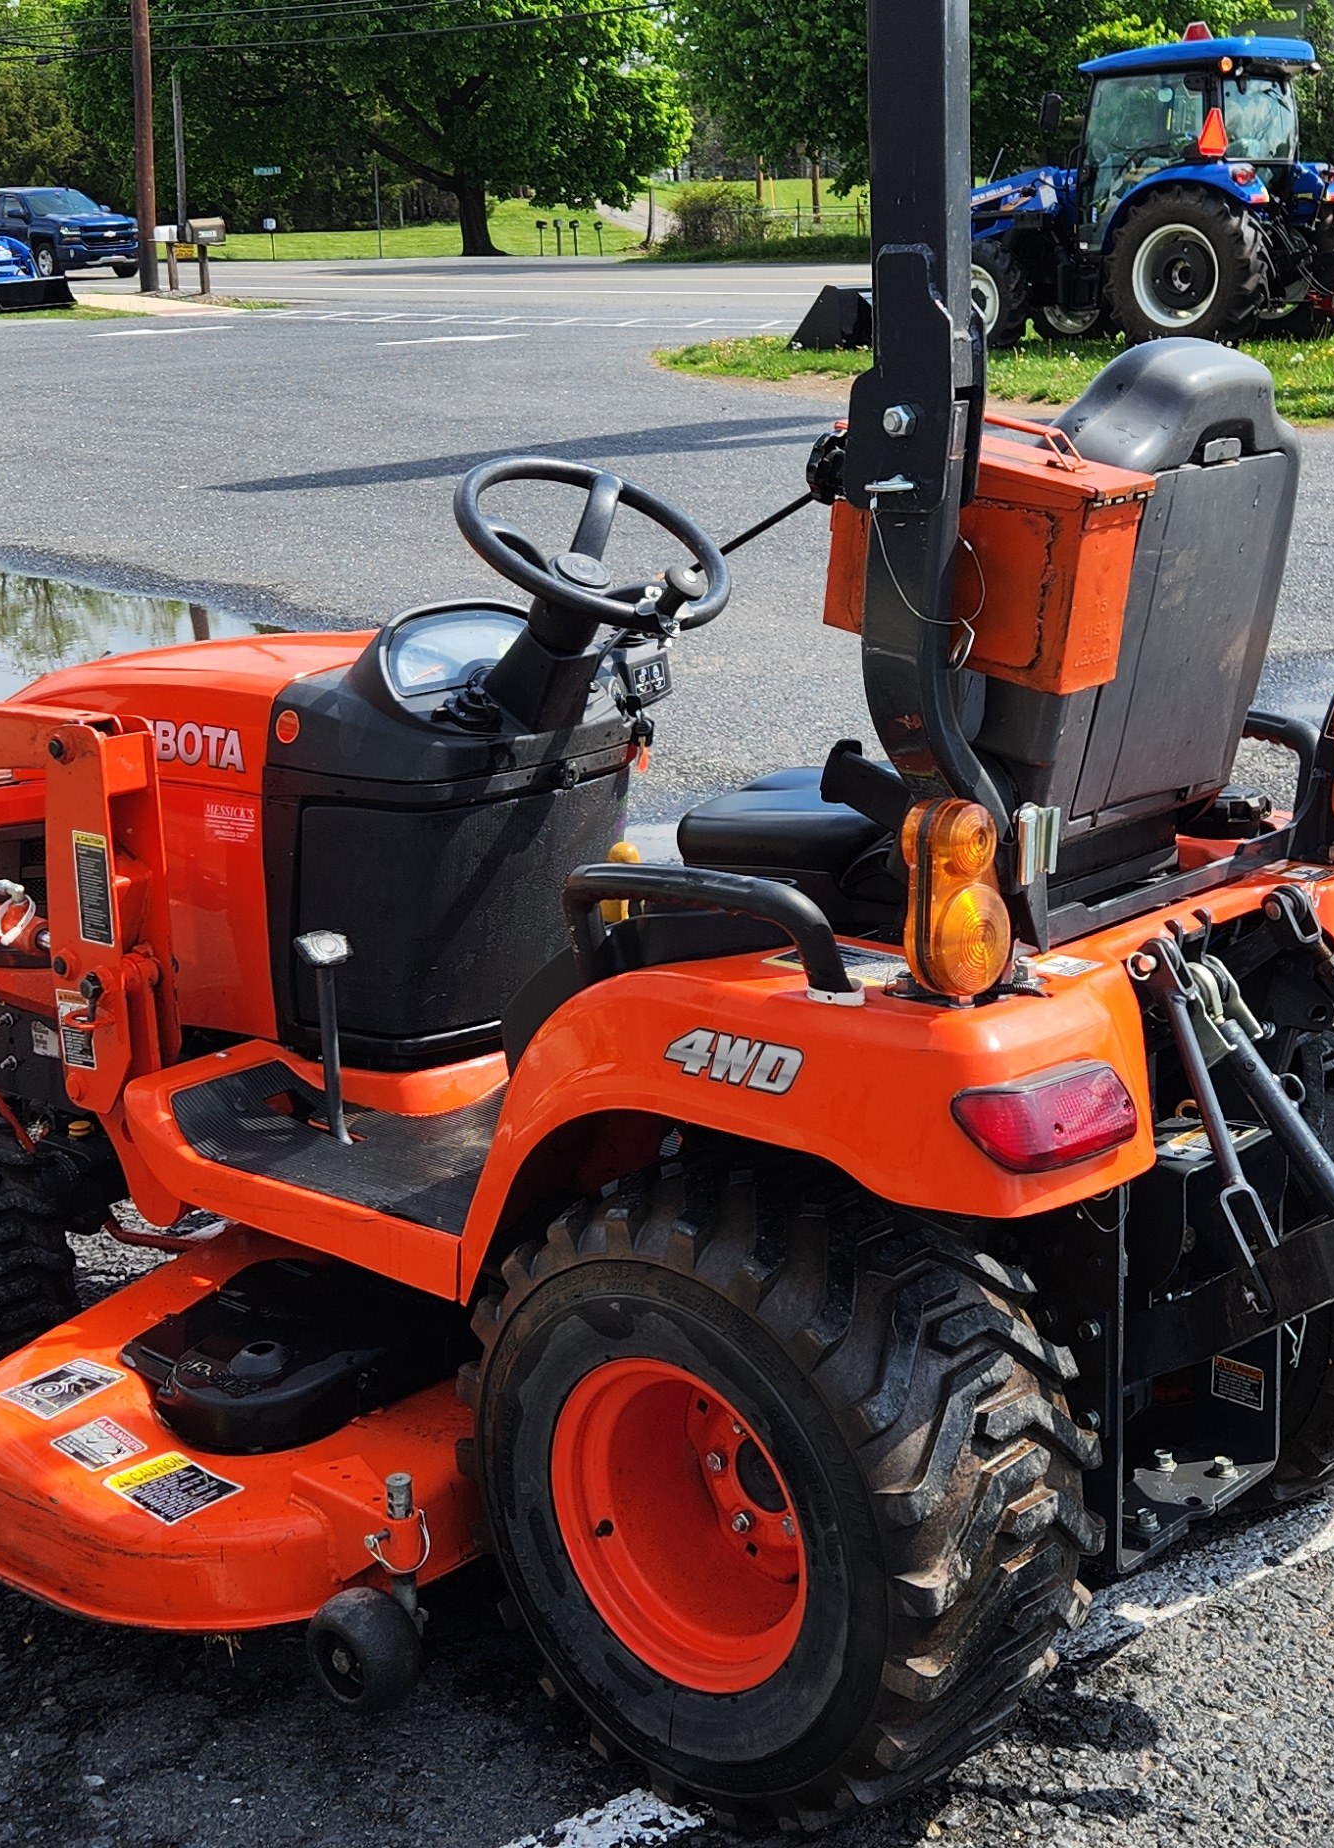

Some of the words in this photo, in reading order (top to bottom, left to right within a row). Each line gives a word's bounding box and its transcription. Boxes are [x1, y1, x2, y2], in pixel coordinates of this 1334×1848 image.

[972, 193, 986, 202] NEW
[986, 184, 1013, 198] HOLLAND
[148, 718, 247, 775] BOTA
[205, 804, 255, 820] MESSICK'S
[80, 835, 104, 846] CAUTION
[663, 1027, 805, 1096] 4WD
[103, 1420, 144, 1453] DANGER
[130, 1455, 187, 1481] CAUTION
